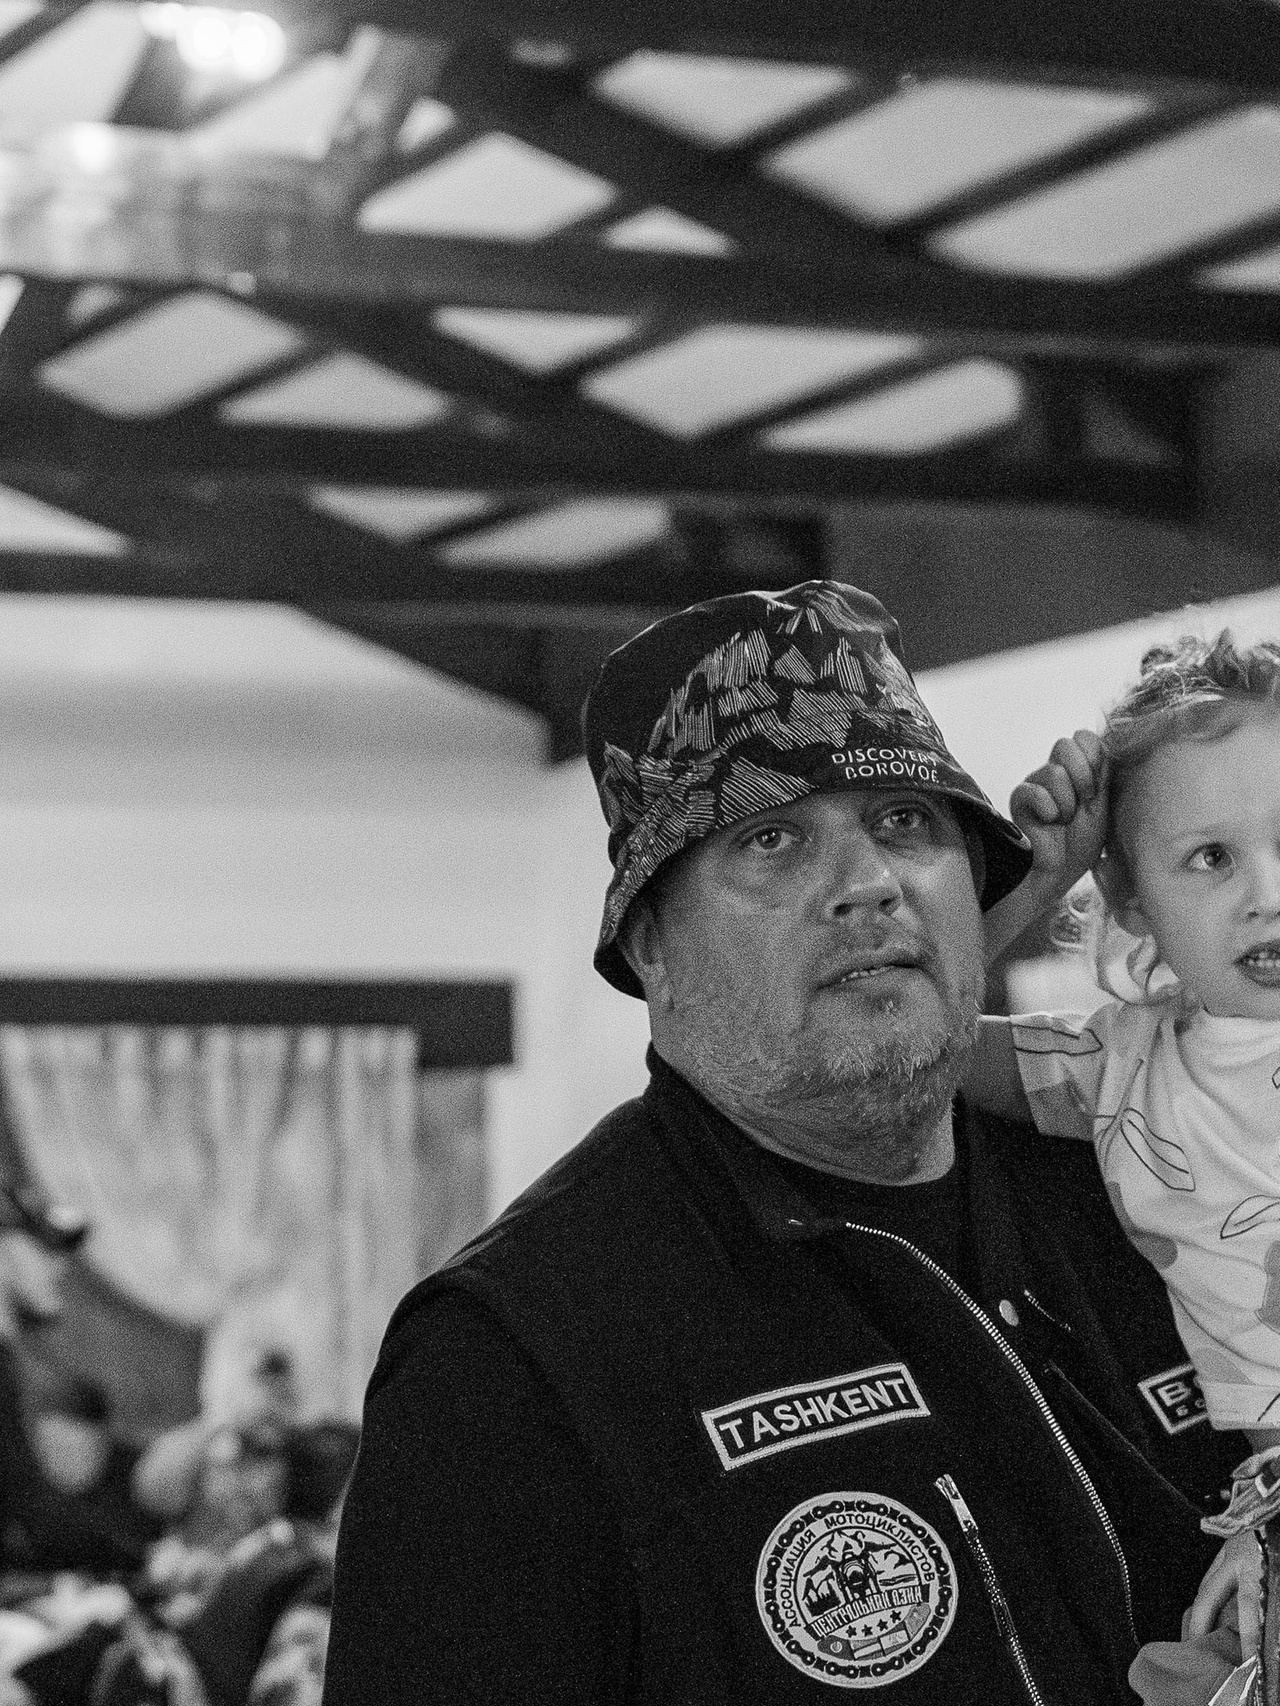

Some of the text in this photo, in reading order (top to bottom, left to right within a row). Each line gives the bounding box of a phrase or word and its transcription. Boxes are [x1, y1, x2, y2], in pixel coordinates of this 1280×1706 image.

[831, 747, 937, 767] DISCOVERY
[845, 761, 940, 784] BOROVOE
[718, 1378, 910, 1450] TASHKENT
[779, 1513, 936, 1628] АССОЦИАЦИЯ МОТОЦИКЛИСТОВ
